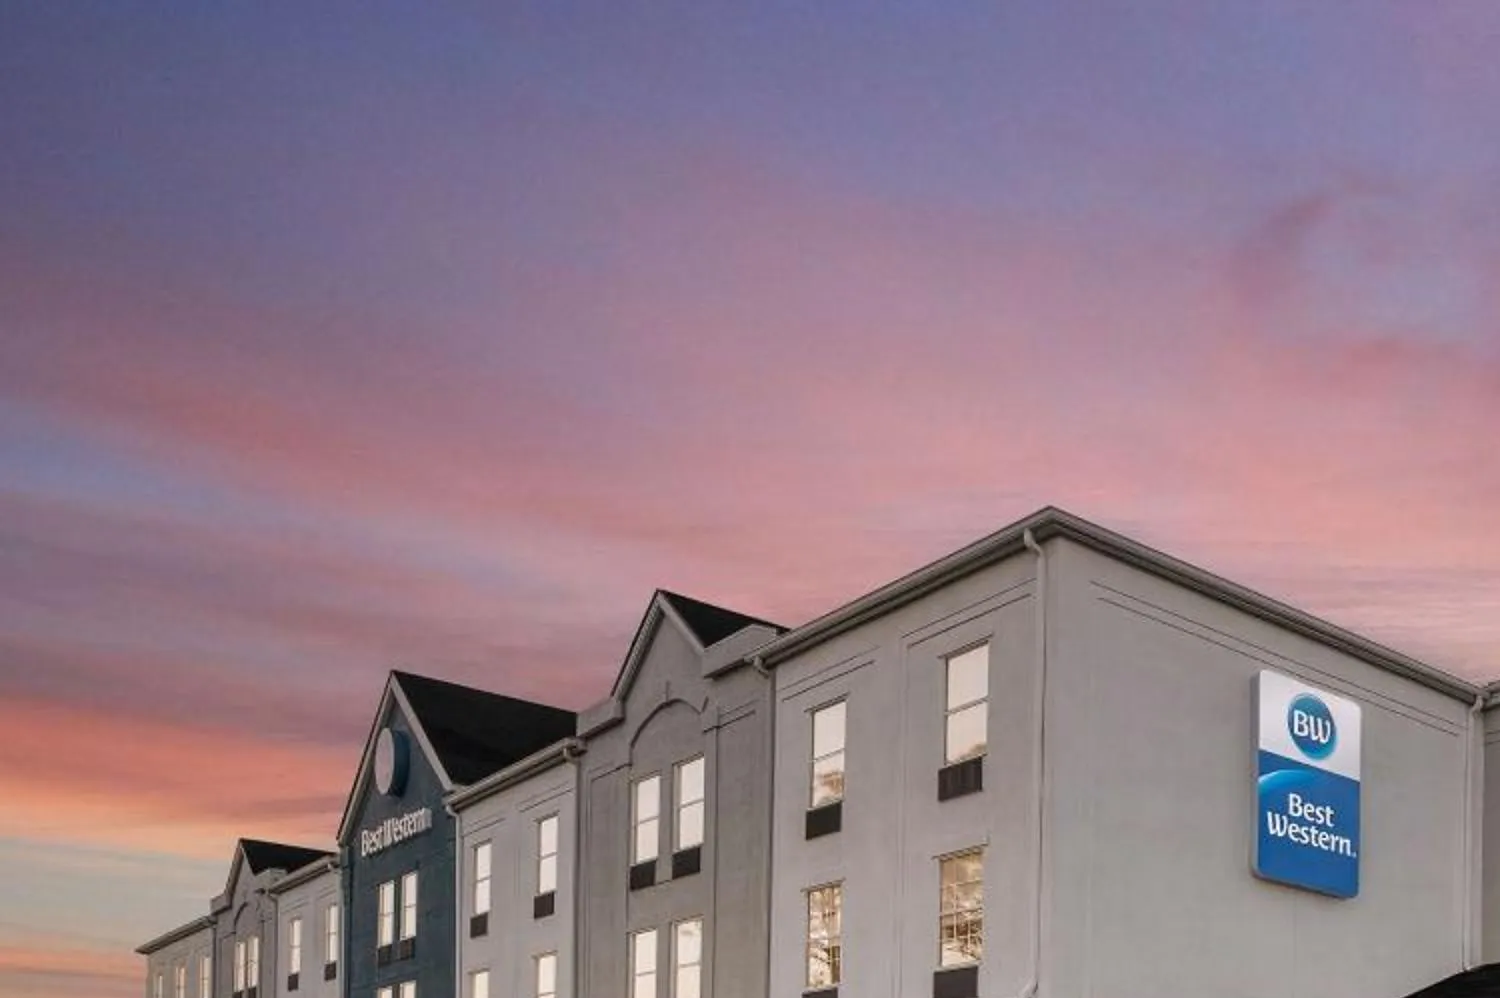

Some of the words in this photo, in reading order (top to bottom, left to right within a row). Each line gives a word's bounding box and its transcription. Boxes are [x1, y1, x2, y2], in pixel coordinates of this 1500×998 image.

[1293, 710, 1331, 744] BW
[1288, 793, 1335, 827] Best
[361, 828, 383, 857] Best
[383, 807, 433, 847] Western
[1266, 811, 1352, 856] Western
